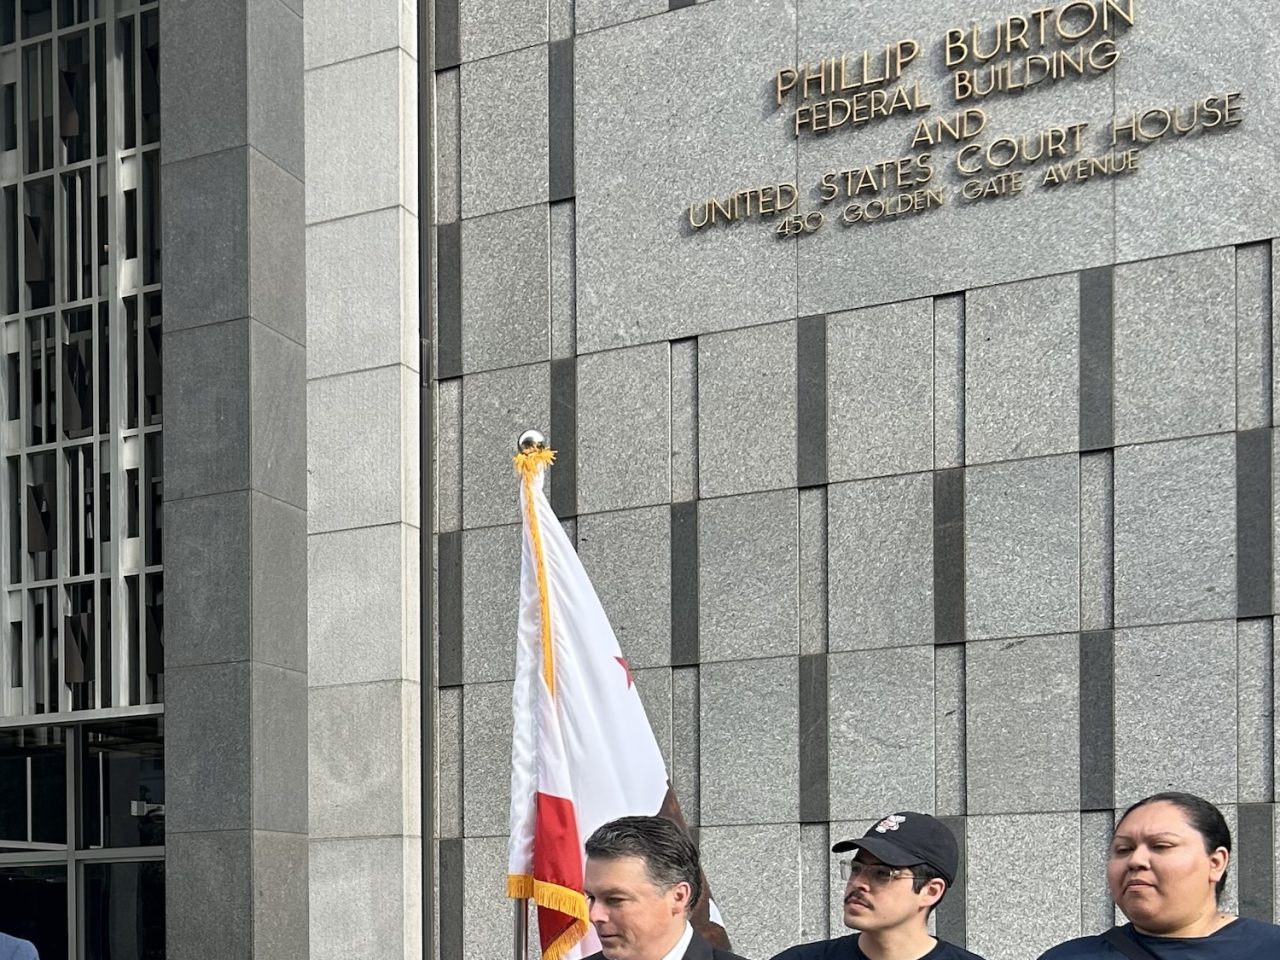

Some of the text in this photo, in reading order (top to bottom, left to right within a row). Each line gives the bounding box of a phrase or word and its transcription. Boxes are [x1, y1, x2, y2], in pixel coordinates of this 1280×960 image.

[776, 0, 1134, 105] PHILLIP BURTON
[795, 39, 1120, 137] FEDERAL BUILDING
[689, 91, 1243, 228] UNITED STATES COURT HOUSE
[911, 108, 986, 148] AND
[776, 149, 1140, 235] 450 GOLDEN GATE AVENUE
